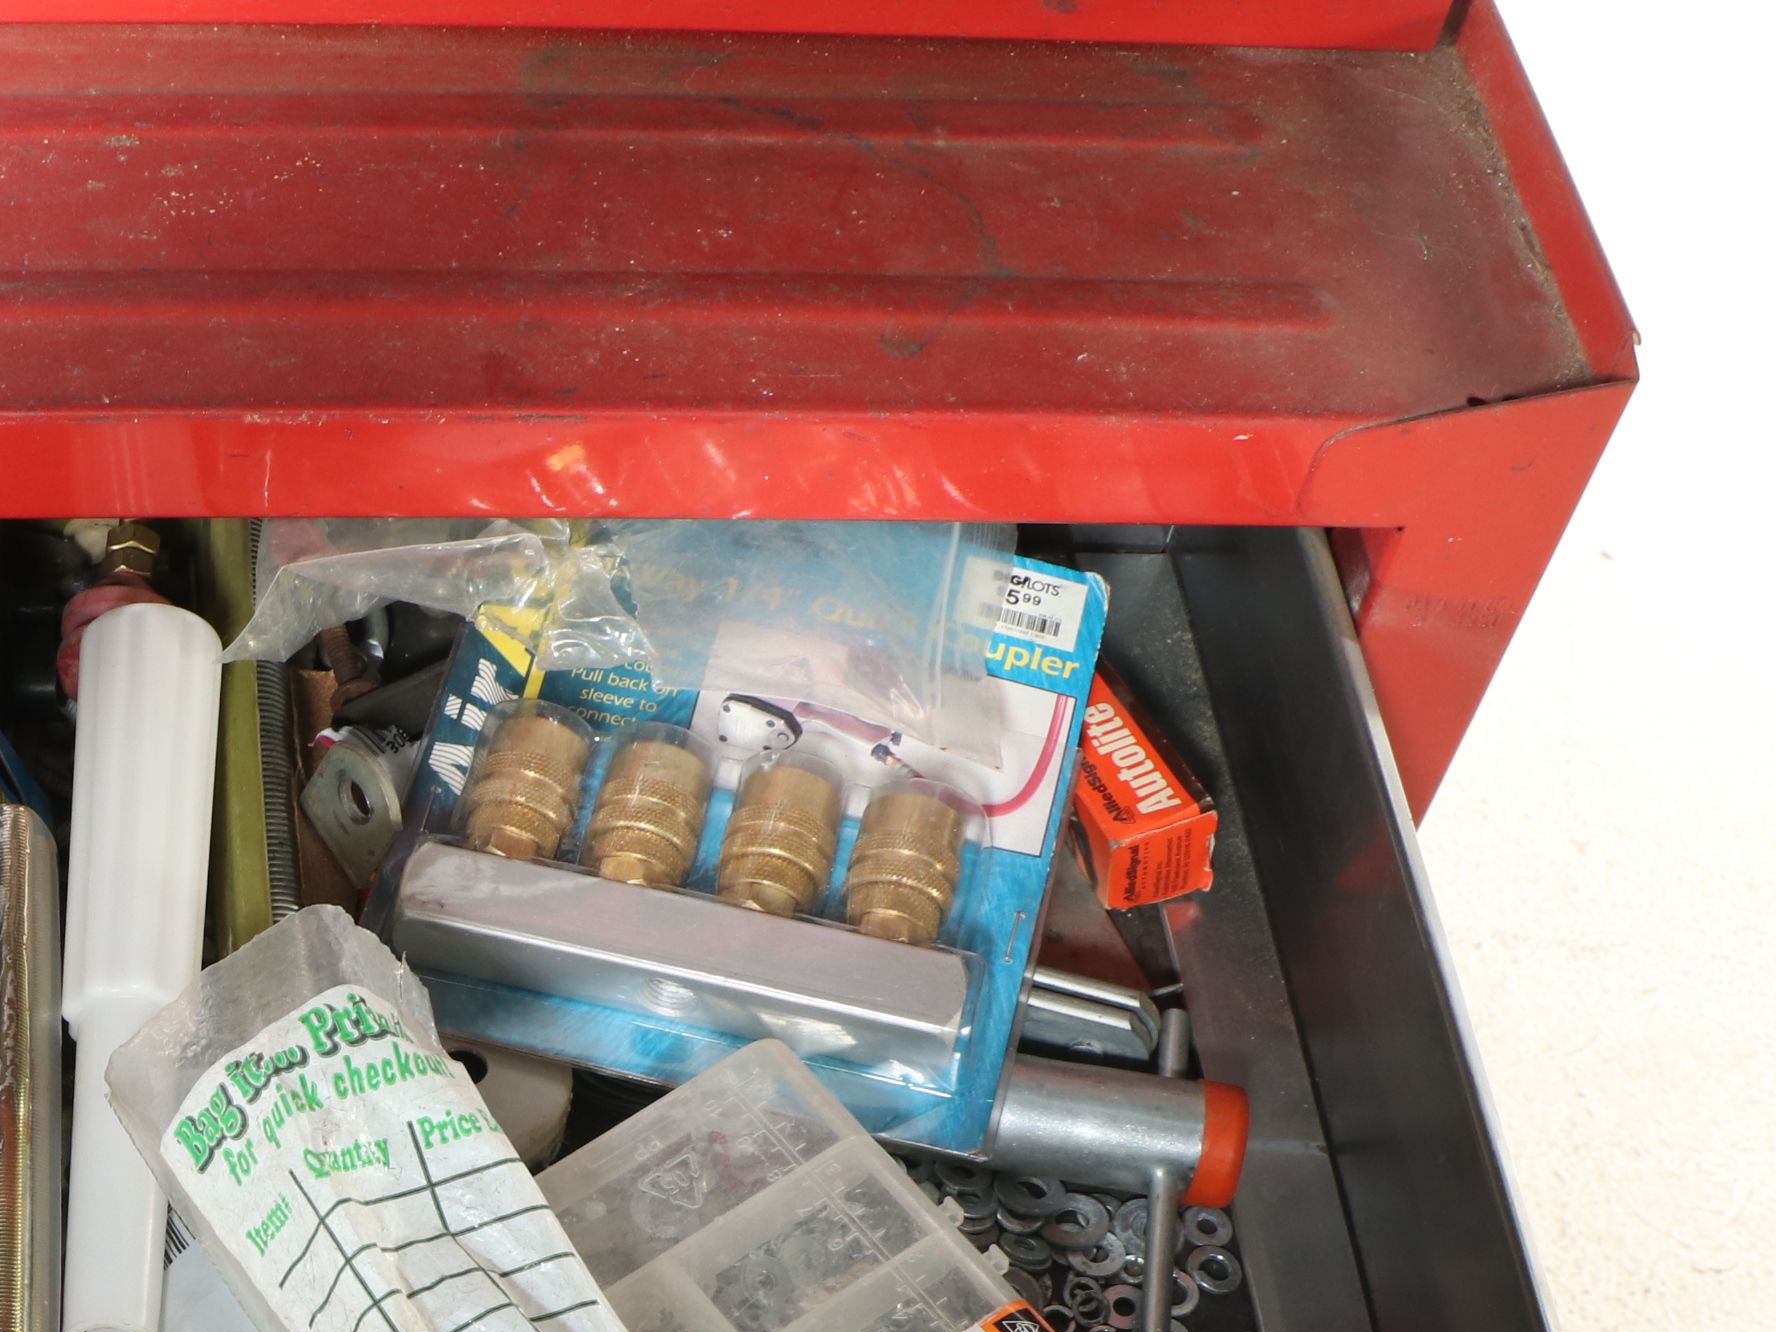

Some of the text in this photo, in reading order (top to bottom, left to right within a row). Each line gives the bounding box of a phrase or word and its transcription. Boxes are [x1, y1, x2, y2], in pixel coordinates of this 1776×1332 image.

[572, 664, 603, 685] Pull
[608, 671, 648, 692] back
[580, 686, 658, 713] sleeve to
[1083, 699, 1182, 815] Autolite
[175, 1084, 247, 1173] Bag
[223, 1138, 258, 1186] for
[262, 1073, 324, 1150] quick
[304, 1137, 392, 1179] Quantity
[417, 1109, 482, 1150] Price
